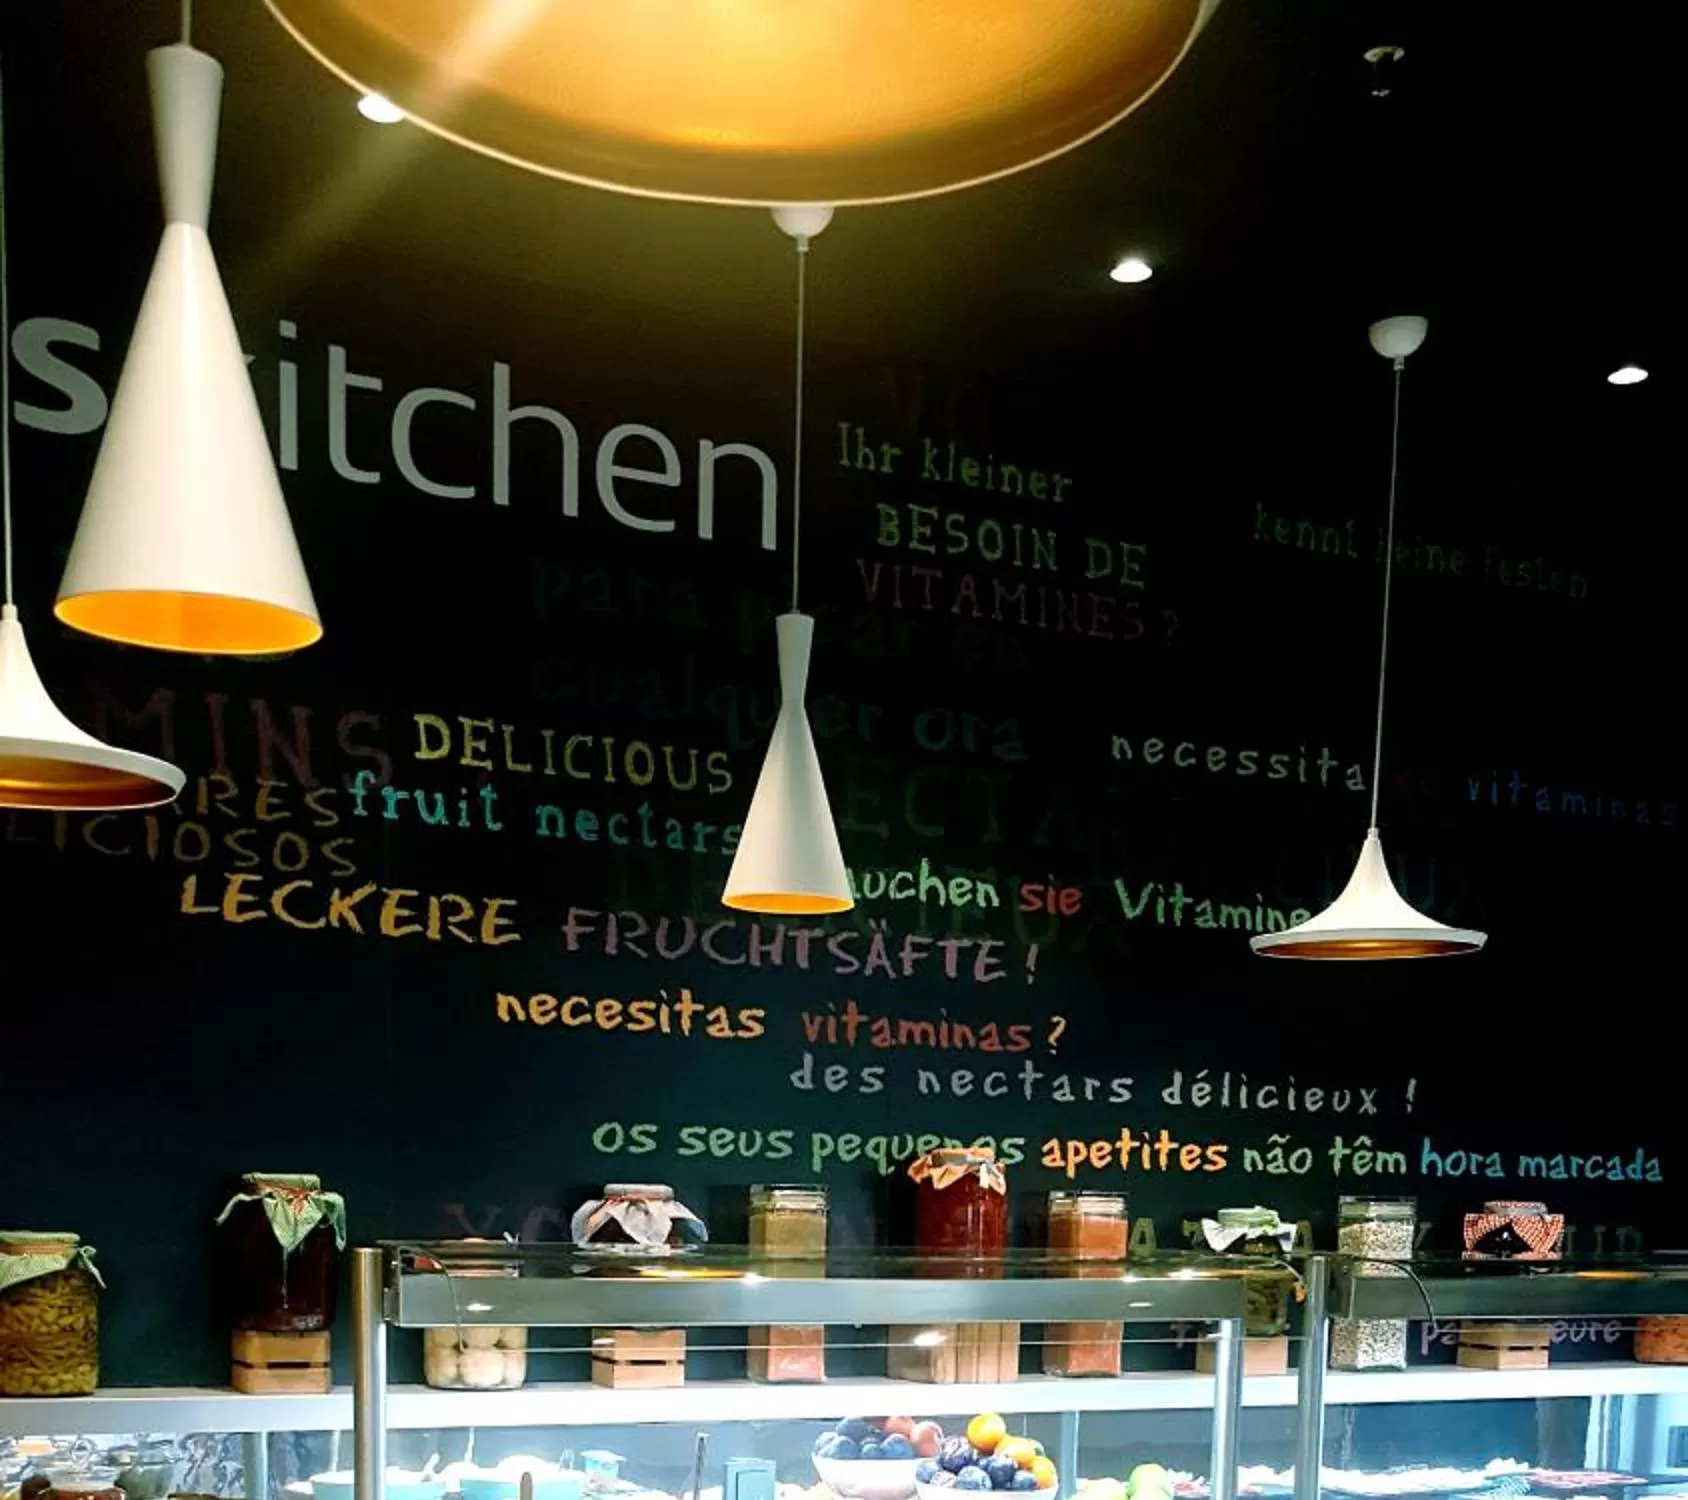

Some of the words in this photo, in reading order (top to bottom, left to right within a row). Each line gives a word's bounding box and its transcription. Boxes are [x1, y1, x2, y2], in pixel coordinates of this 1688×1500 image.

[245, 320, 780, 552] itchen
[837, 420, 904, 476] Ihr
[921, 436, 1073, 503] kleiner
[875, 502, 1060, 573] BESOIN
[1083, 535, 1149, 590] DE
[856, 557, 1144, 640] VITAMINES
[413, 713, 734, 795] DELICIOUS
[1110, 735, 1366, 790] necessita
[174, 770, 341, 829] RES
[347, 768, 502, 832] fruit
[535, 798, 742, 855] nectars
[179, 872, 523, 948] LECKERE
[1019, 873, 1083, 916] sie
[496, 988, 768, 1040] necesitas
[802, 1000, 1032, 1054] vitaminas
[791, 1053, 885, 1096] des
[917, 1060, 1134, 1107] nectars
[1160, 1070, 1378, 1118] délicieux
[678, 1125, 794, 1160] seus
[1041, 1127, 1228, 1179] apetites
[1243, 1132, 1313, 1178] não
[1330, 1135, 1407, 1178] têm
[1420, 1135, 1503, 1180] hora
[1517, 1145, 1664, 1184] marcada
